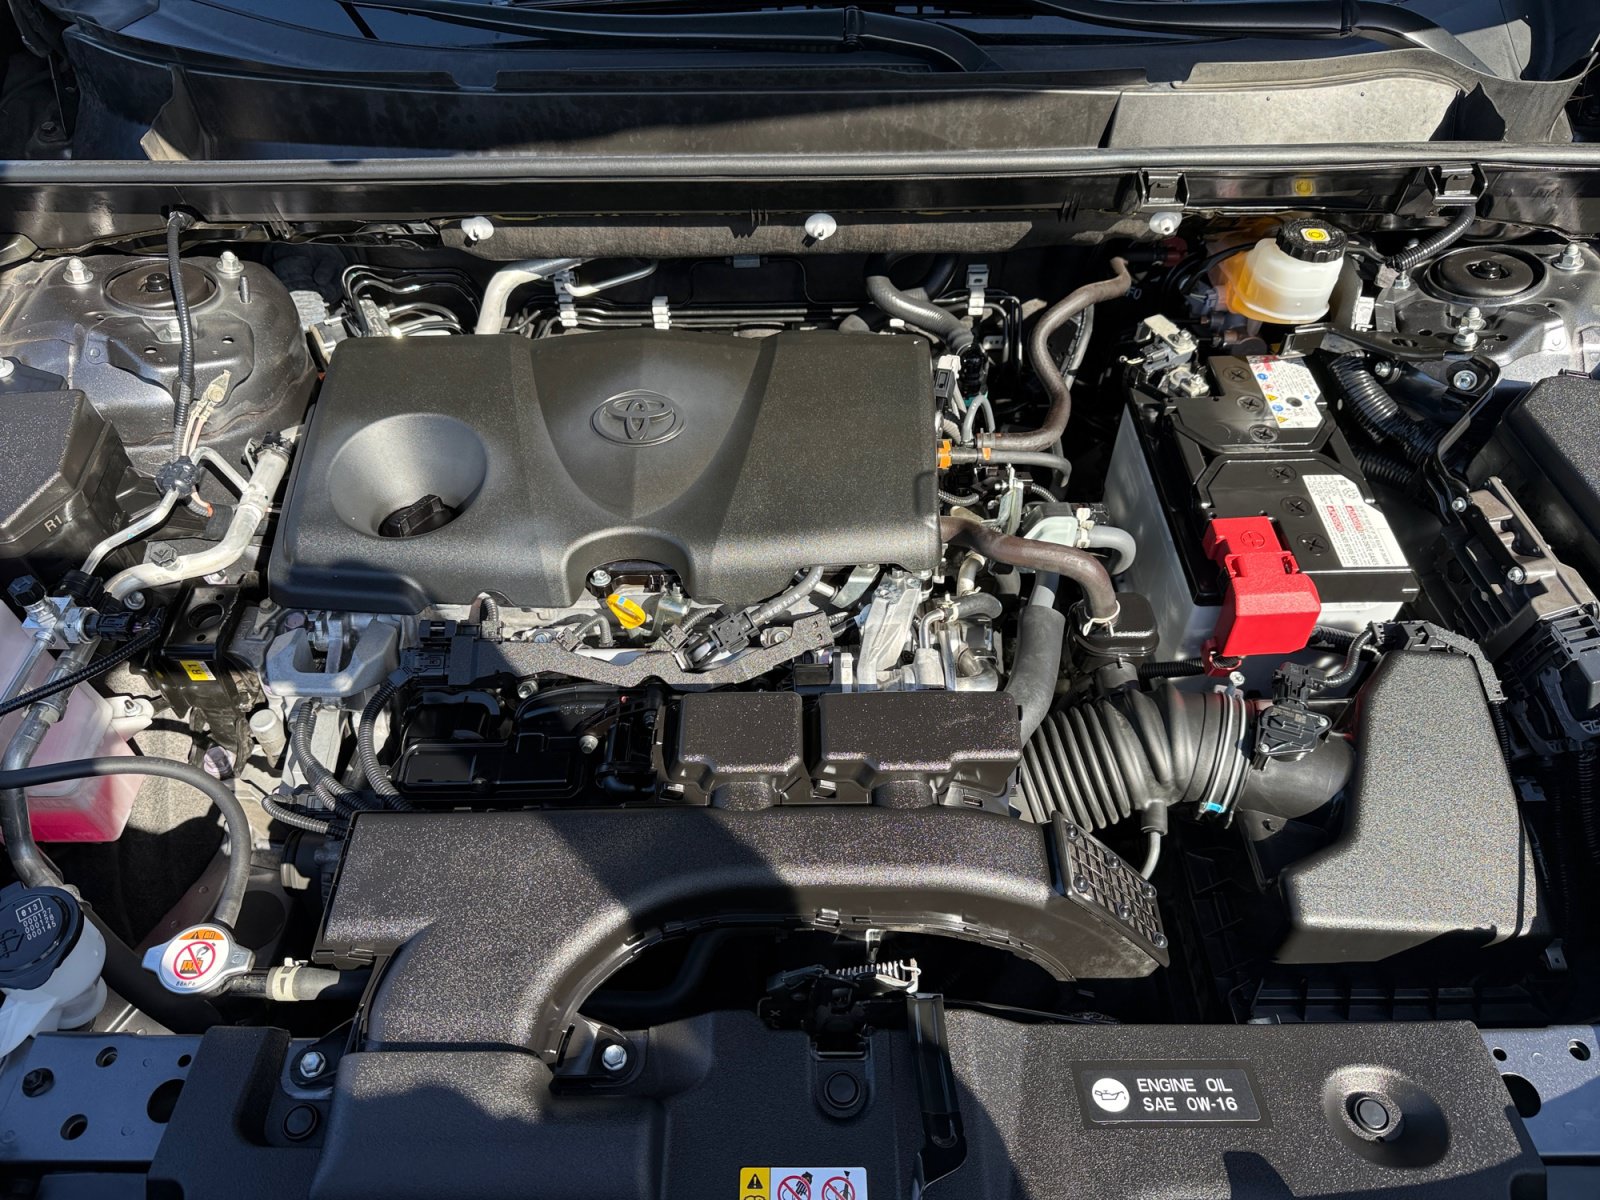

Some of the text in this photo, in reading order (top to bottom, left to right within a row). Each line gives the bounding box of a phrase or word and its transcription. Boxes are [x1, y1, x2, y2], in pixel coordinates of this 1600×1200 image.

[43, 514, 63, 533] R1
[1136, 1078, 1233, 1093] ENGINE OIL
[1142, 1097, 1238, 1112] SAE 0W-16
